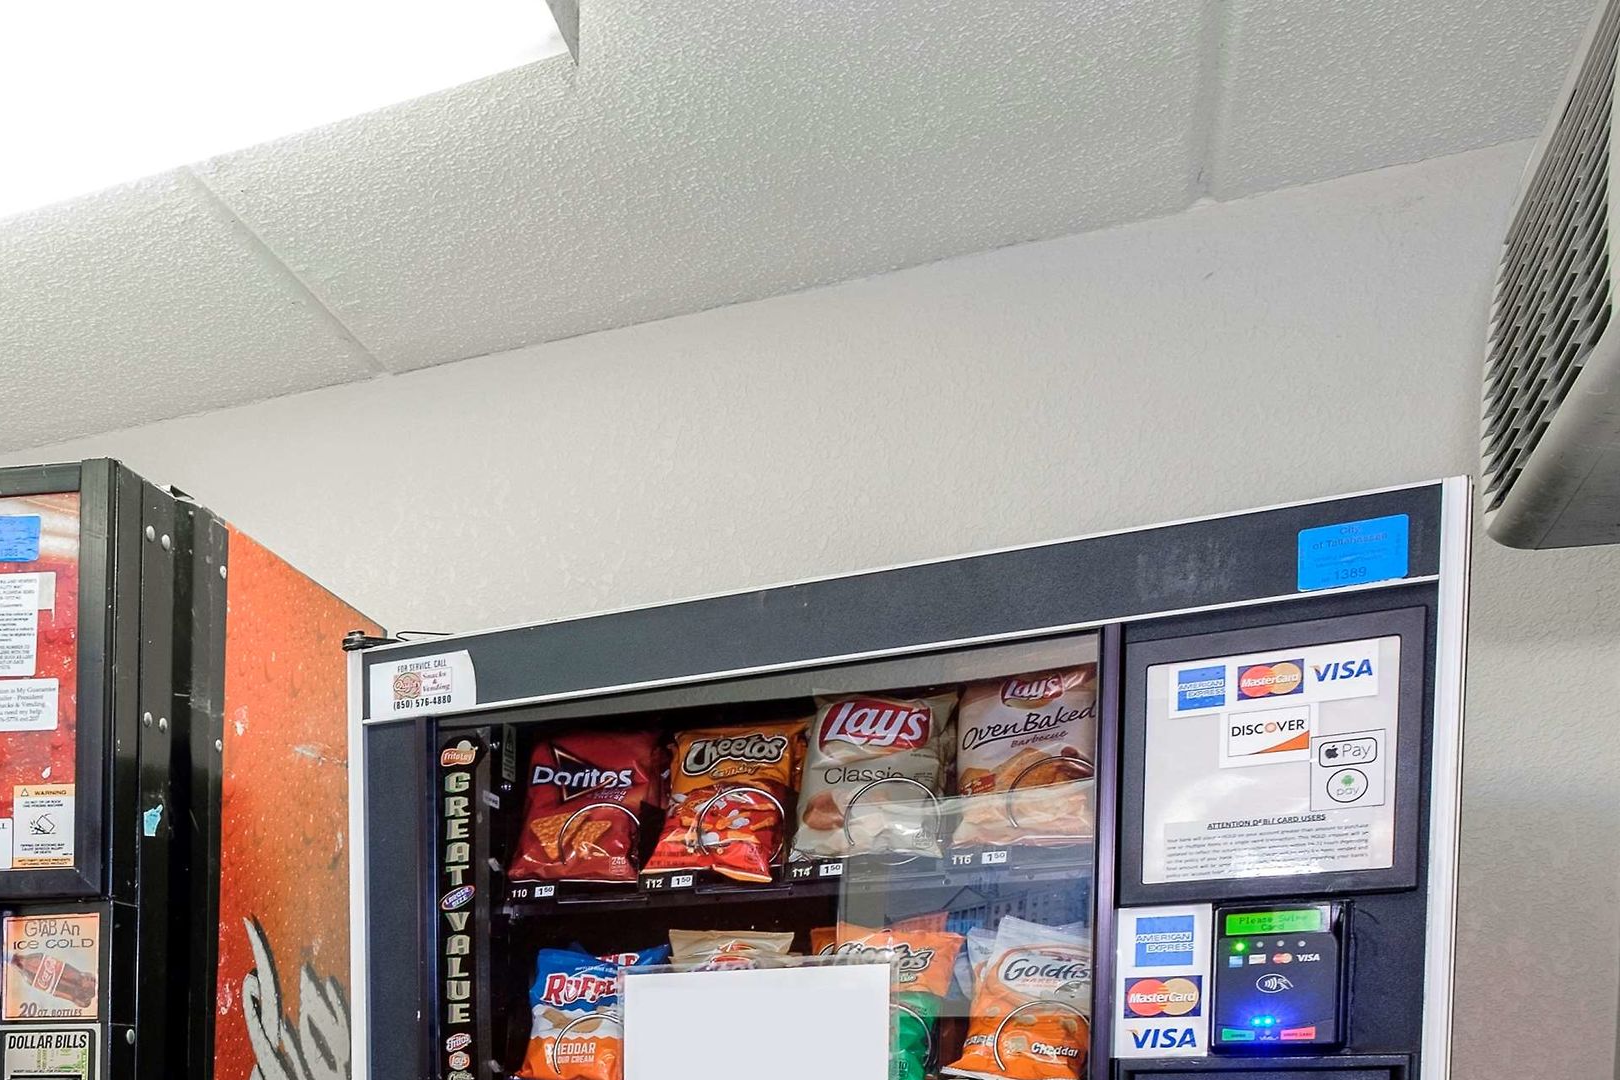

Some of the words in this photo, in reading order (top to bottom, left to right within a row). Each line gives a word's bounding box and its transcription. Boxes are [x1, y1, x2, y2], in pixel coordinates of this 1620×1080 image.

[398, 665, 408, 673] FOR
[434, 659, 447, 668] CALL
[1240, 672, 1300, 688] MasterCard
[1310, 658, 1373, 682] VISA
[1004, 677, 1064, 700] Lay's
[1179, 679, 1224, 691] AMERICAN
[1186, 688, 1225, 699] EXPRESS
[393, 699, 413, 711] (850)
[415, 694, 452, 708] 576-4880
[823, 702, 928, 748] Lay's
[962, 726, 1020, 751] Oven
[1022, 704, 1097, 733] Baked
[1231, 719, 1305, 737] DISCOVER
[683, 733, 788, 775] Cheetos
[1342, 743, 1371, 760] Pay
[532, 766, 633, 788] Doritos
[824, 766, 905, 785] Classic
[1336, 787, 1360, 797] pay
[444, 771, 471, 886] GREAT
[1207, 820, 1250, 830] ATTENTION
[1277, 816, 1299, 825] CARD
[1301, 813, 1327, 822] USERS
[951, 854, 975, 865] 116
[792, 866, 812, 878] 114
[645, 878, 663, 888] 112
[511, 888, 528, 899] 110
[1238, 915, 1273, 925] Please
[45, 938, 94, 949] COLD
[1136, 932, 1192, 944] AMERICAN
[1146, 942, 1195, 953] EXPRESS
[1296, 953, 1321, 962] VISA
[444, 911, 471, 1025] VALUE
[1004, 958, 1092, 981] Goldfis
[543, 973, 619, 1006] RUFFL
[1130, 990, 1196, 1003] MasterCard
[19, 1002, 38, 1017] 20
[51, 1008, 83, 1016] BOTTLES
[8, 1034, 53, 1050] DOLLAR
[55, 1034, 87, 1049] BILLS
[1130, 1027, 1198, 1050] VISA
